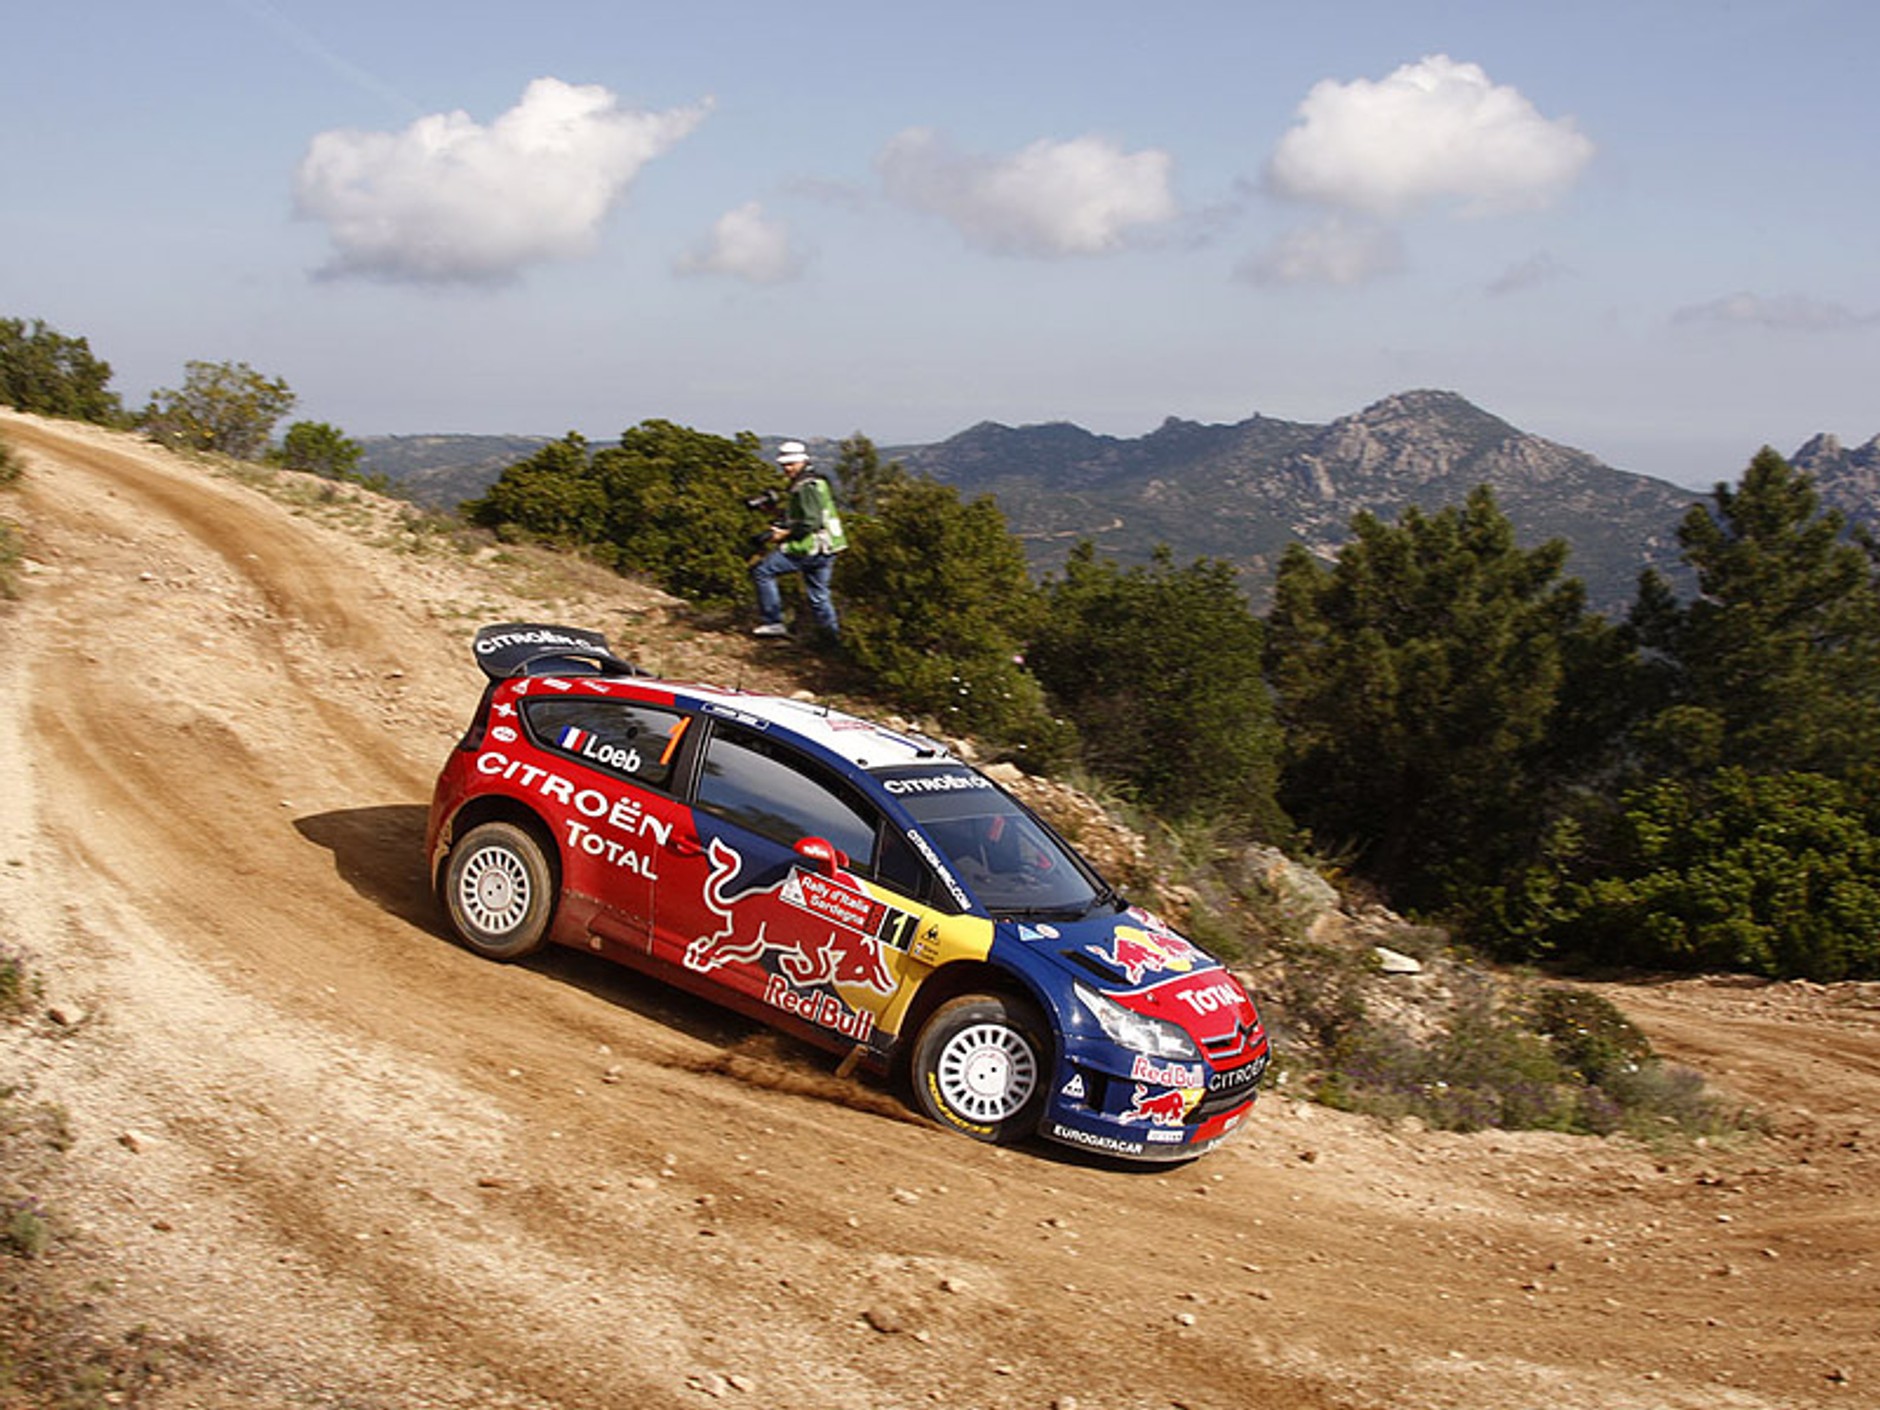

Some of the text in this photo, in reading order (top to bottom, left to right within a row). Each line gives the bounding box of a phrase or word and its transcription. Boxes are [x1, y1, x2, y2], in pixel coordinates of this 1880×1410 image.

[583, 735, 641, 773] Loeb
[660, 717, 691, 765] 1
[476, 752, 673, 846] CITROËN
[565, 820, 659, 880] TOTAL
[802, 876, 829, 898] Rally
[809, 895, 865, 926] Sardegna
[893, 912, 909, 946] 1
[1175, 982, 1247, 1017] TOTAL
